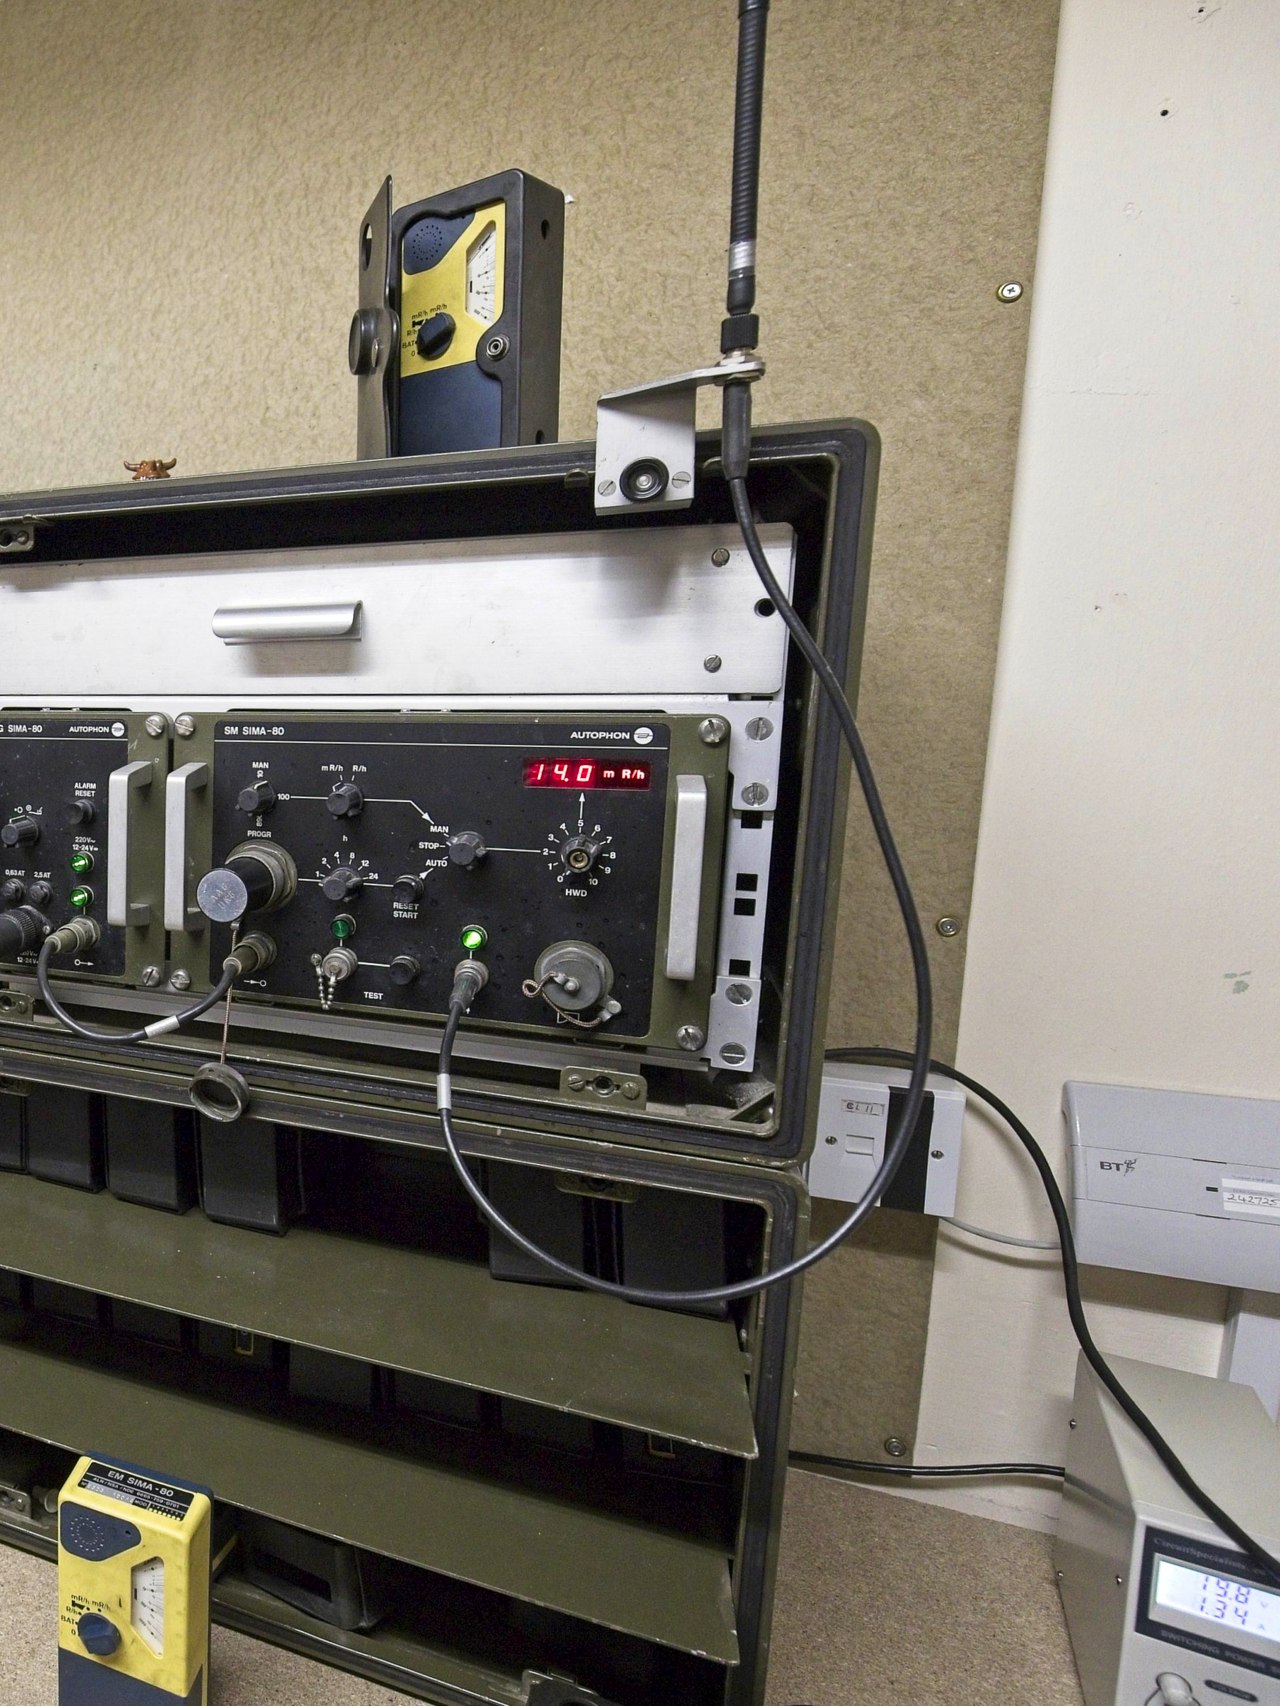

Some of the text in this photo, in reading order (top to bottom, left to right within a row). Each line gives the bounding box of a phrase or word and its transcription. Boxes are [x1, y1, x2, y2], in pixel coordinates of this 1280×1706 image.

[7, 724, 43, 734] SIMA-80
[69, 726, 110, 734] AUTOPHON
[224, 726, 285, 736] SM SIMA-80
[570, 731, 631, 740] AUTOPHON
[252, 761, 270, 769] MAN
[352, 765, 368, 773] R/h
[535, 763, 593, 783] 14.0
[74, 782, 97, 790] ALARM
[75, 790, 96, 798] RESET
[277, 793, 291, 801] 100
[430, 825, 449, 834] MAN
[560, 823, 566, 831] 4
[595, 824, 601, 832] 6
[247, 830, 272, 838] PROGR
[606, 836, 613, 844] 7
[418, 842, 440, 850] STOP
[543, 848, 549, 856] 2
[425, 859, 448, 868] AUTO
[605, 866, 612, 875] 9
[588, 878, 599, 886] 10
[565, 889, 588, 898] HWD
[393, 902, 420, 911] RESET
[393, 911, 419, 919] START
[364, 991, 384, 1000] TEST
[1100, 1161, 1124, 1172] BT
[107, 1470, 125, 1481] EM
